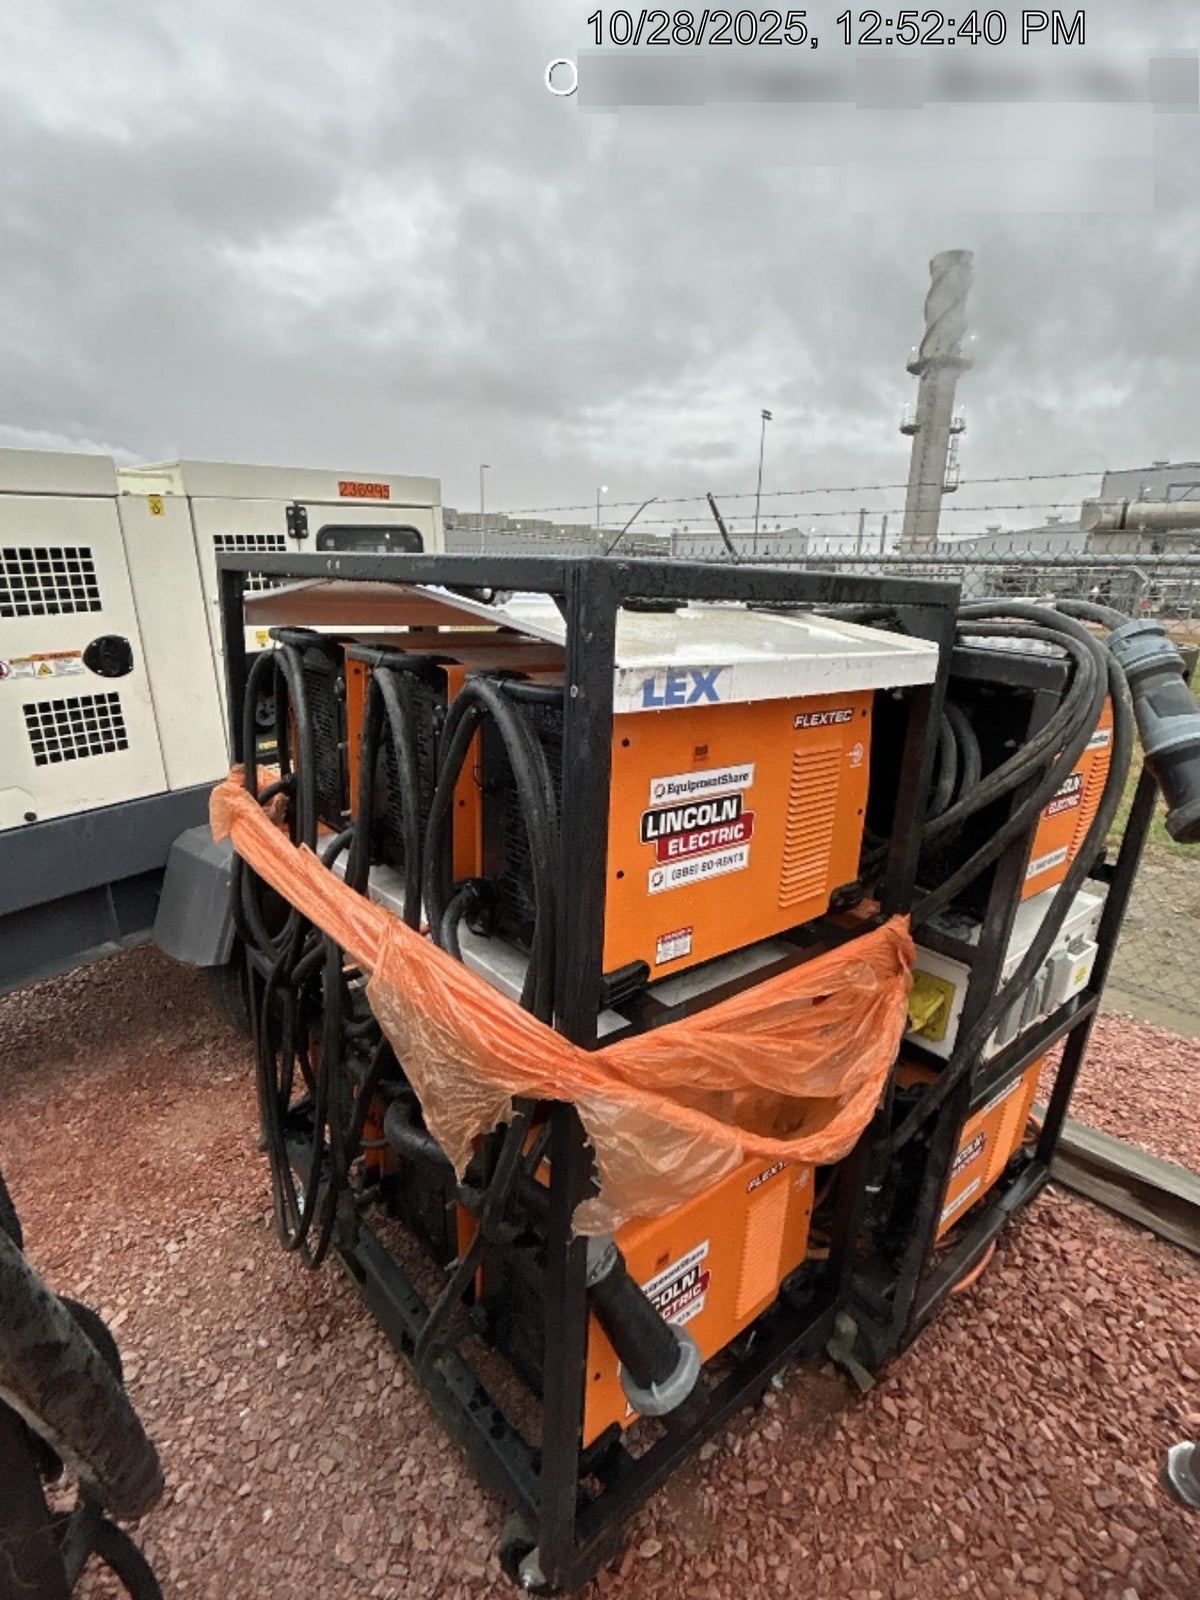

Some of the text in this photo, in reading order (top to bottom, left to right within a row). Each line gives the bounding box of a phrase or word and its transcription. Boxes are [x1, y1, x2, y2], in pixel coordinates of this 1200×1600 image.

[642, 665, 723, 708] LEX
[794, 709, 853, 728] FLEXTEC
[667, 772, 750, 796] EquipmentShare
[646, 798, 739, 838] LINCOLN
[668, 824, 745, 856] ELECTRIC
[651, 1269, 697, 1310] COLN
[663, 1283, 702, 1319] CTRIC
